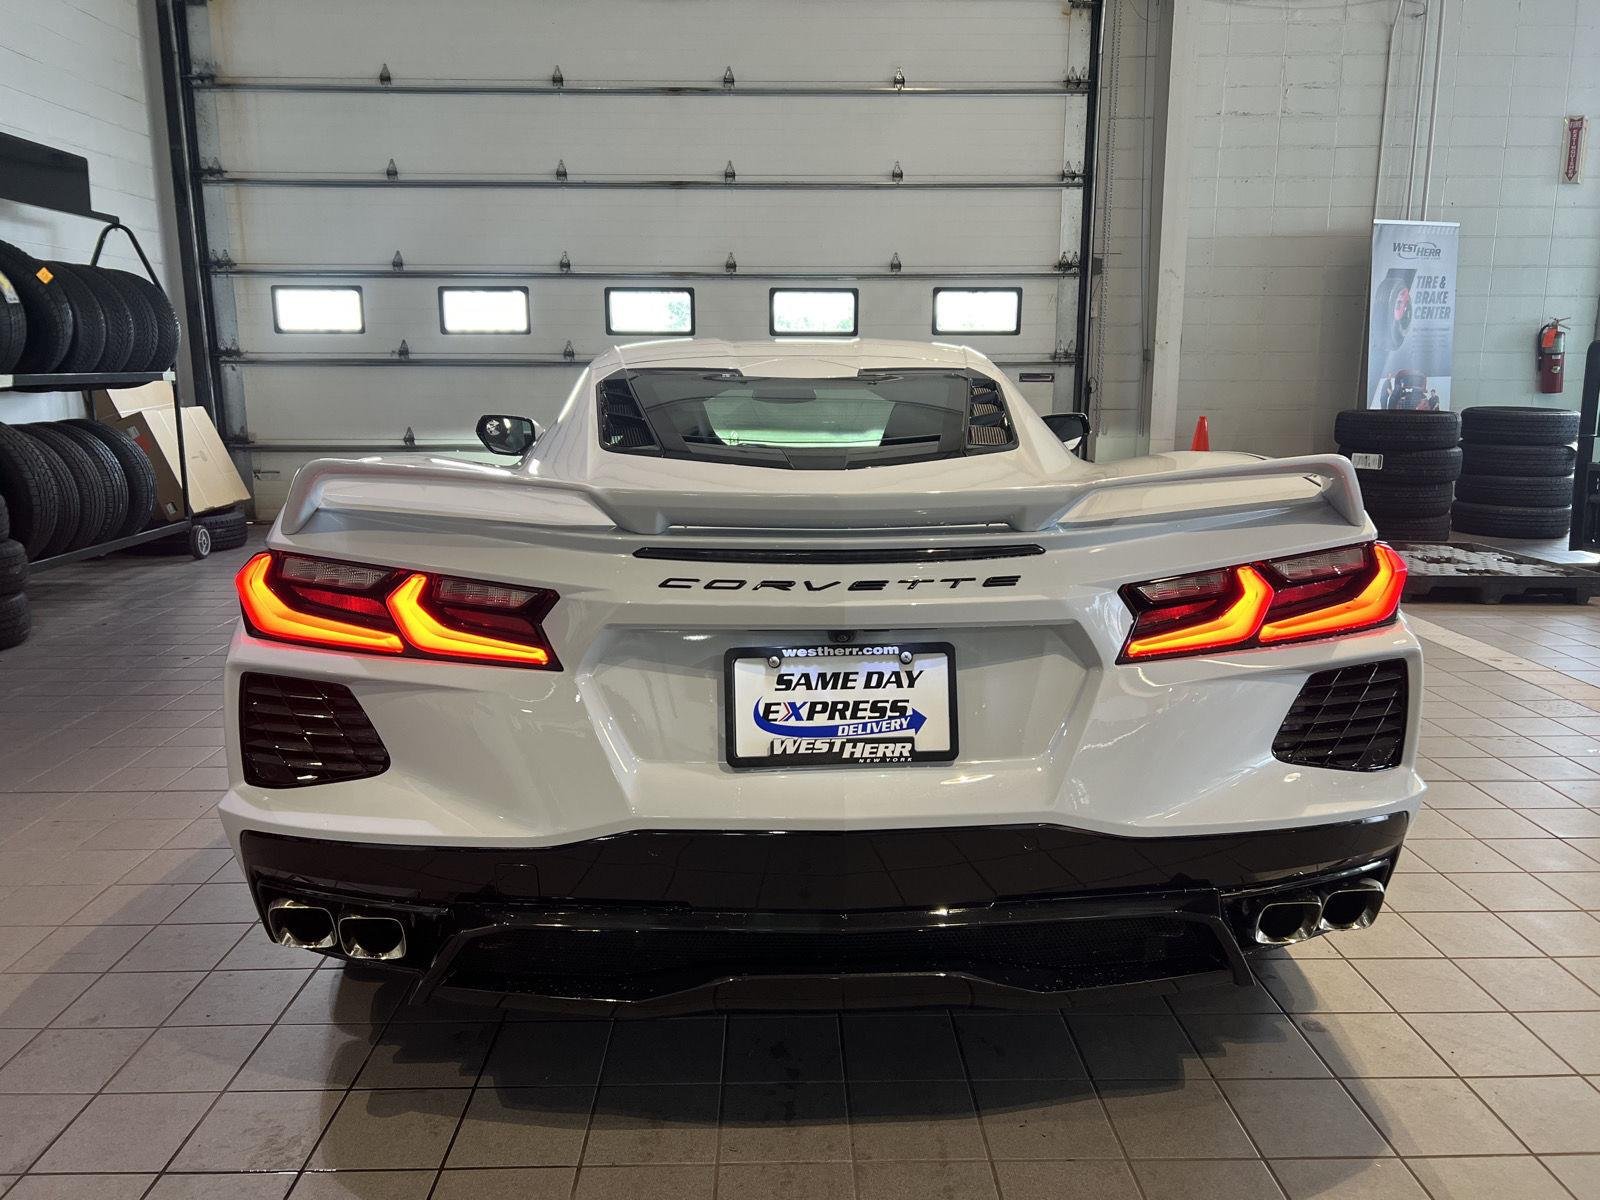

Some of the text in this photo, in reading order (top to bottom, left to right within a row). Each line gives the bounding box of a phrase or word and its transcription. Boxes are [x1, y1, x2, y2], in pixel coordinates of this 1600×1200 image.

[1392, 242, 1442, 257] WEST HERR
[1416, 275, 1447, 289] TIRE &
[1415, 291, 1448, 304] BRAKE
[1414, 306, 1451, 320] CENTER
[658, 575, 1022, 592] CORVETTE
[781, 645, 900, 657] westherr.com
[774, 670, 925, 692] SAME DAY
[761, 699, 910, 722] EXPRESS
[837, 716, 911, 737] DELIVERY
